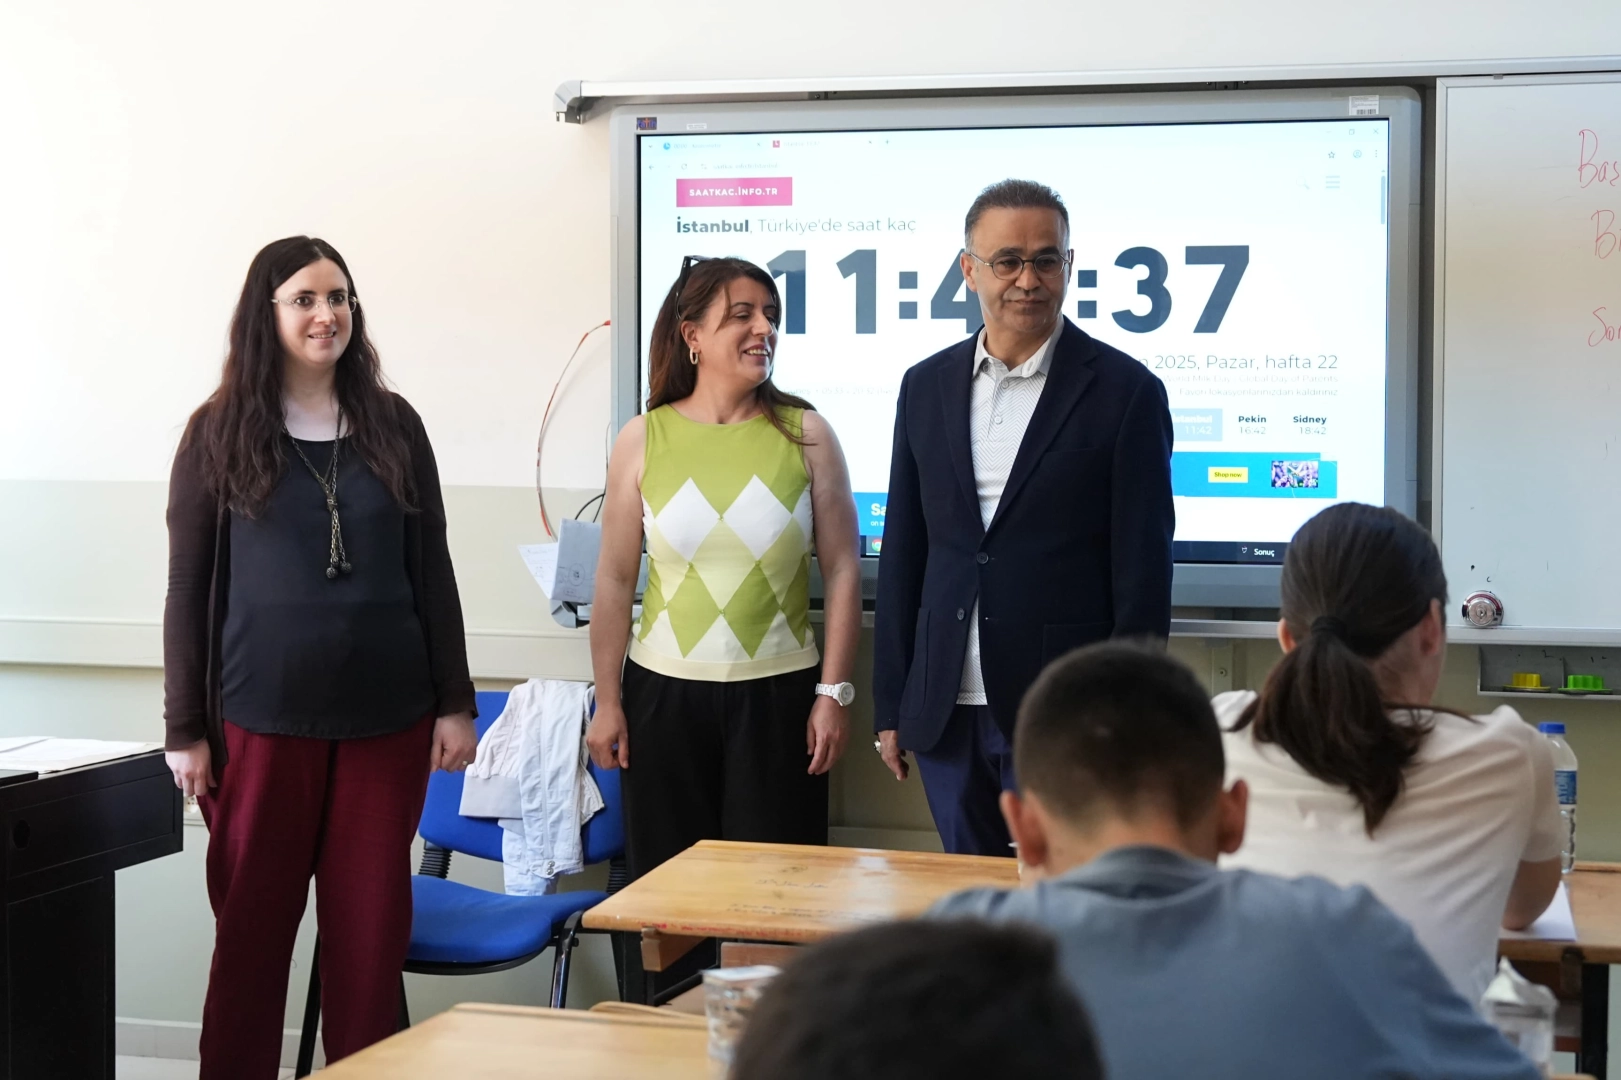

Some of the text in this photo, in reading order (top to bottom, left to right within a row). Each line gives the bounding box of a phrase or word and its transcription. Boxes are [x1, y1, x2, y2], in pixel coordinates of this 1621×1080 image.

[758, 217, 842, 236] Türkiye'de
[847, 218, 882, 233] saat
[887, 217, 916, 235] kaç
[1154, 354, 1200, 371] 2025,
[1206, 354, 1259, 371] Pazar,
[1265, 354, 1312, 370] hafta
[1317, 354, 1338, 370] 22
[1238, 415, 1267, 424] Pekin
[1292, 415, 1327, 426] Sidney
[1185, 425, 1212, 435] 11:42
[1239, 426, 1267, 435] 16:42
[1299, 426, 1327, 435] 18:42
[1214, 471, 1229, 479] Shop
[1253, 548, 1275, 558] Sonuç
